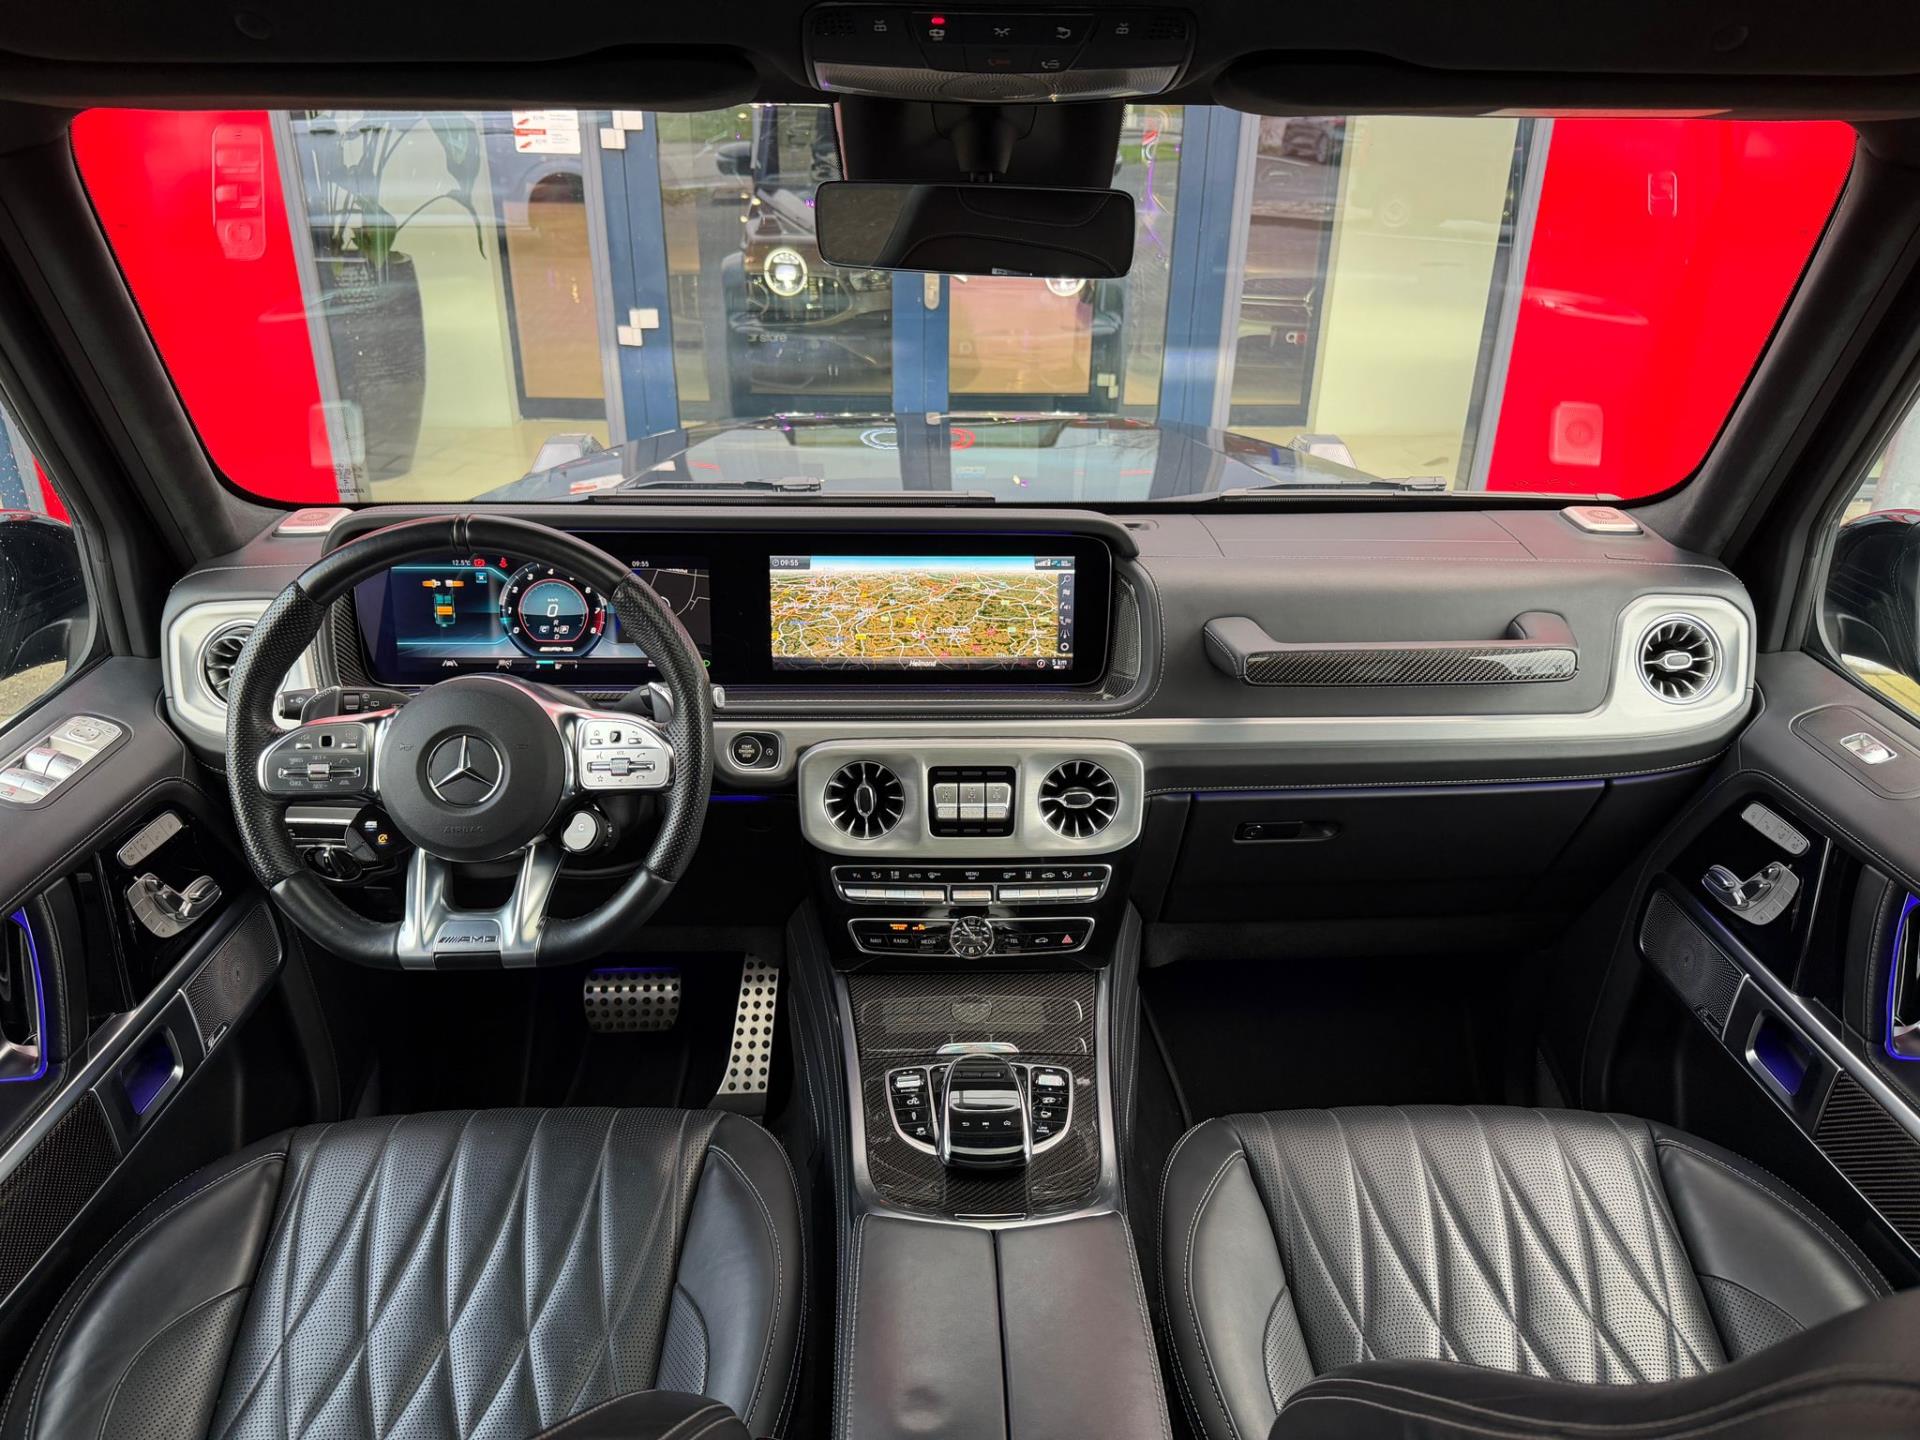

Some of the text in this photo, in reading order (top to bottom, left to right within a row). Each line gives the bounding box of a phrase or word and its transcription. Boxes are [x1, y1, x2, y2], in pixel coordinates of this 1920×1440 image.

[631, 560, 650, 568] 09:55
[780, 559, 799, 567] 09:55
[546, 603, 559, 618] 0
[909, 659, 937, 668] Helmond
[455, 935, 496, 943] AMG
